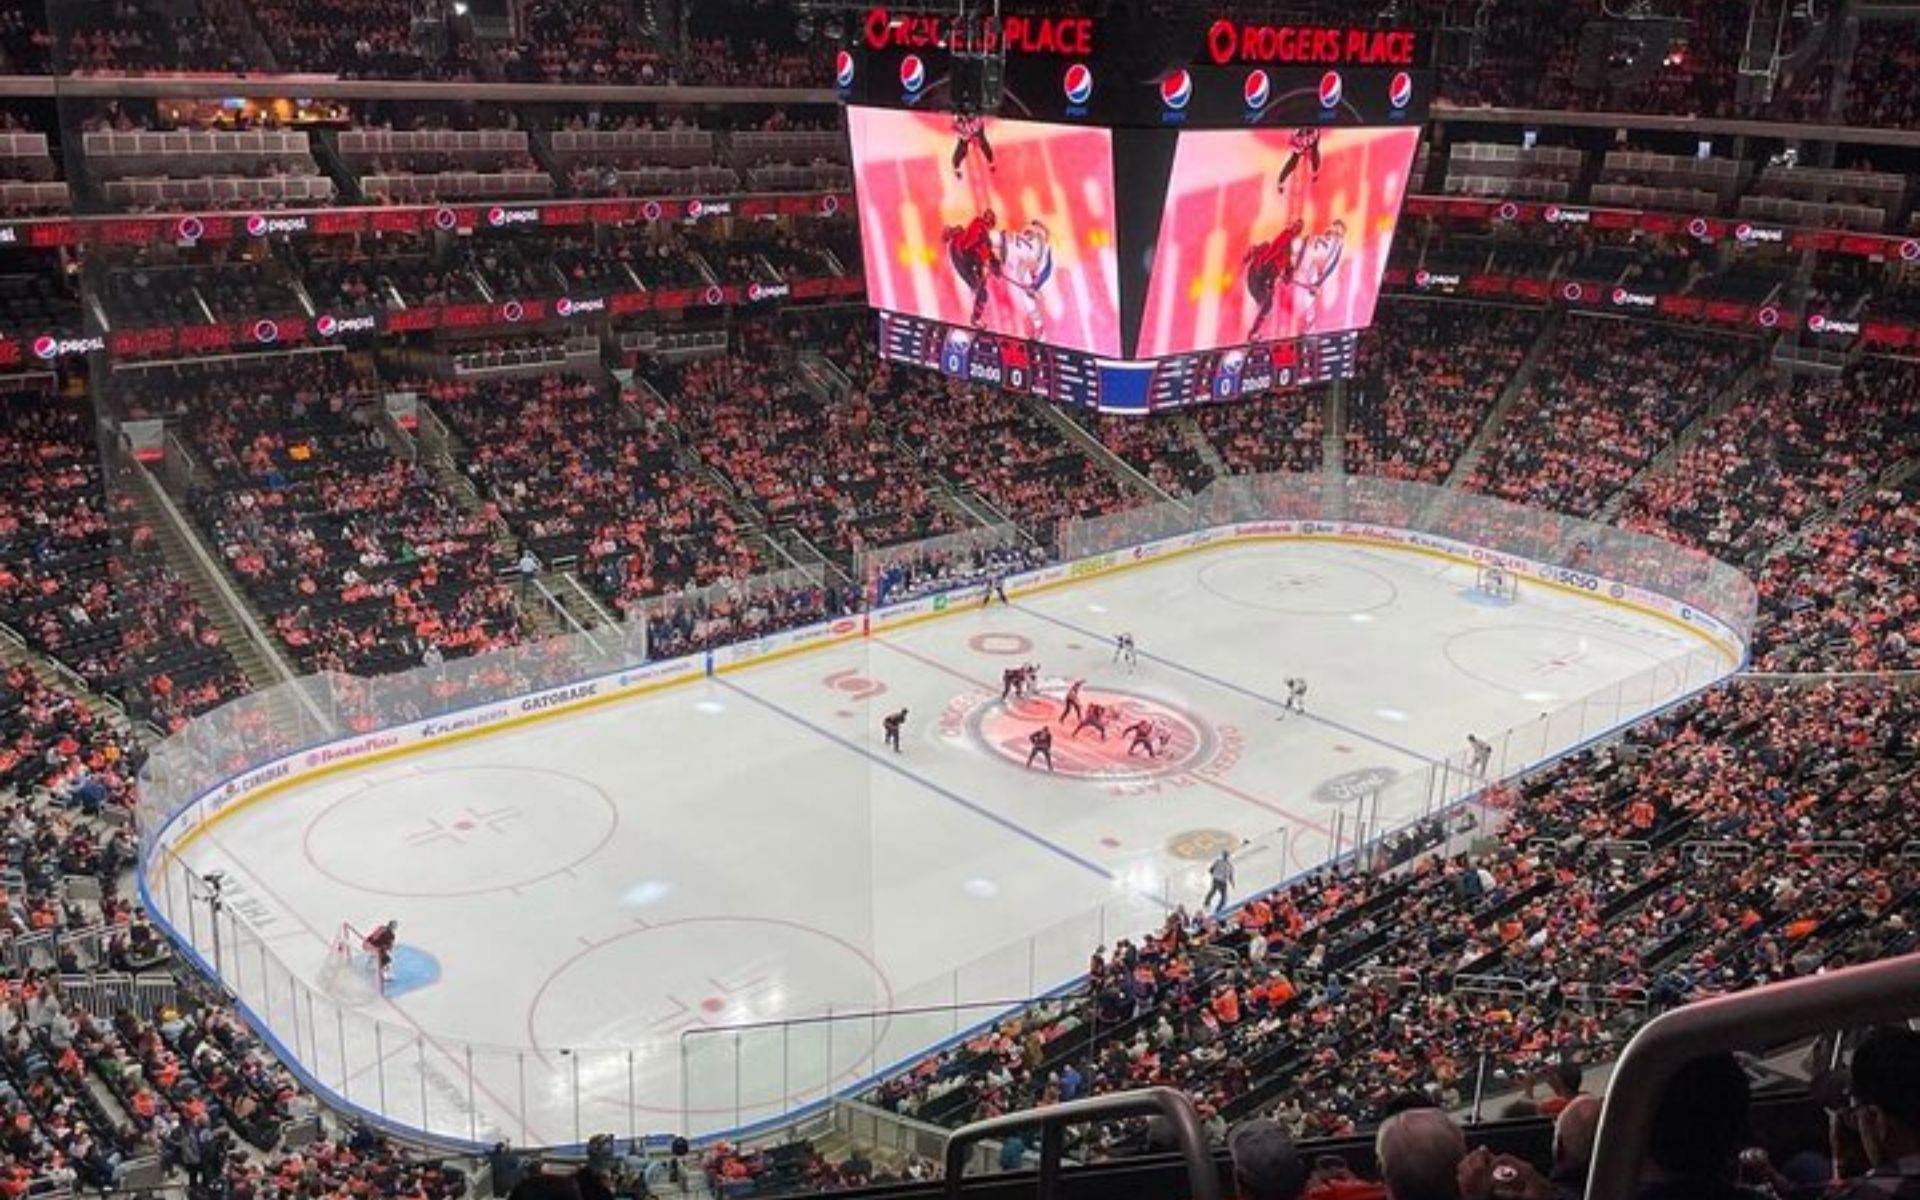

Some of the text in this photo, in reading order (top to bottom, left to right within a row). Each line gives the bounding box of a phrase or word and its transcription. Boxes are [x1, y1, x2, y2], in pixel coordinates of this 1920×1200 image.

[1004, 17, 1093, 53] PLACE
[1242, 27, 1415, 63] ROGERS PLACE
[505, 208, 538, 222] pepsi
[268, 216, 307, 234] pepsi
[571, 298, 604, 313] pepsi
[337, 315, 375, 331] pepsi
[57, 336, 104, 353] pepsi
[950, 355, 959, 372] 0
[1011, 369, 1022, 386] 0
[1280, 368, 1290, 386] 0
[1220, 379, 1231, 396] 0
[521, 684, 598, 711] GATORADE
